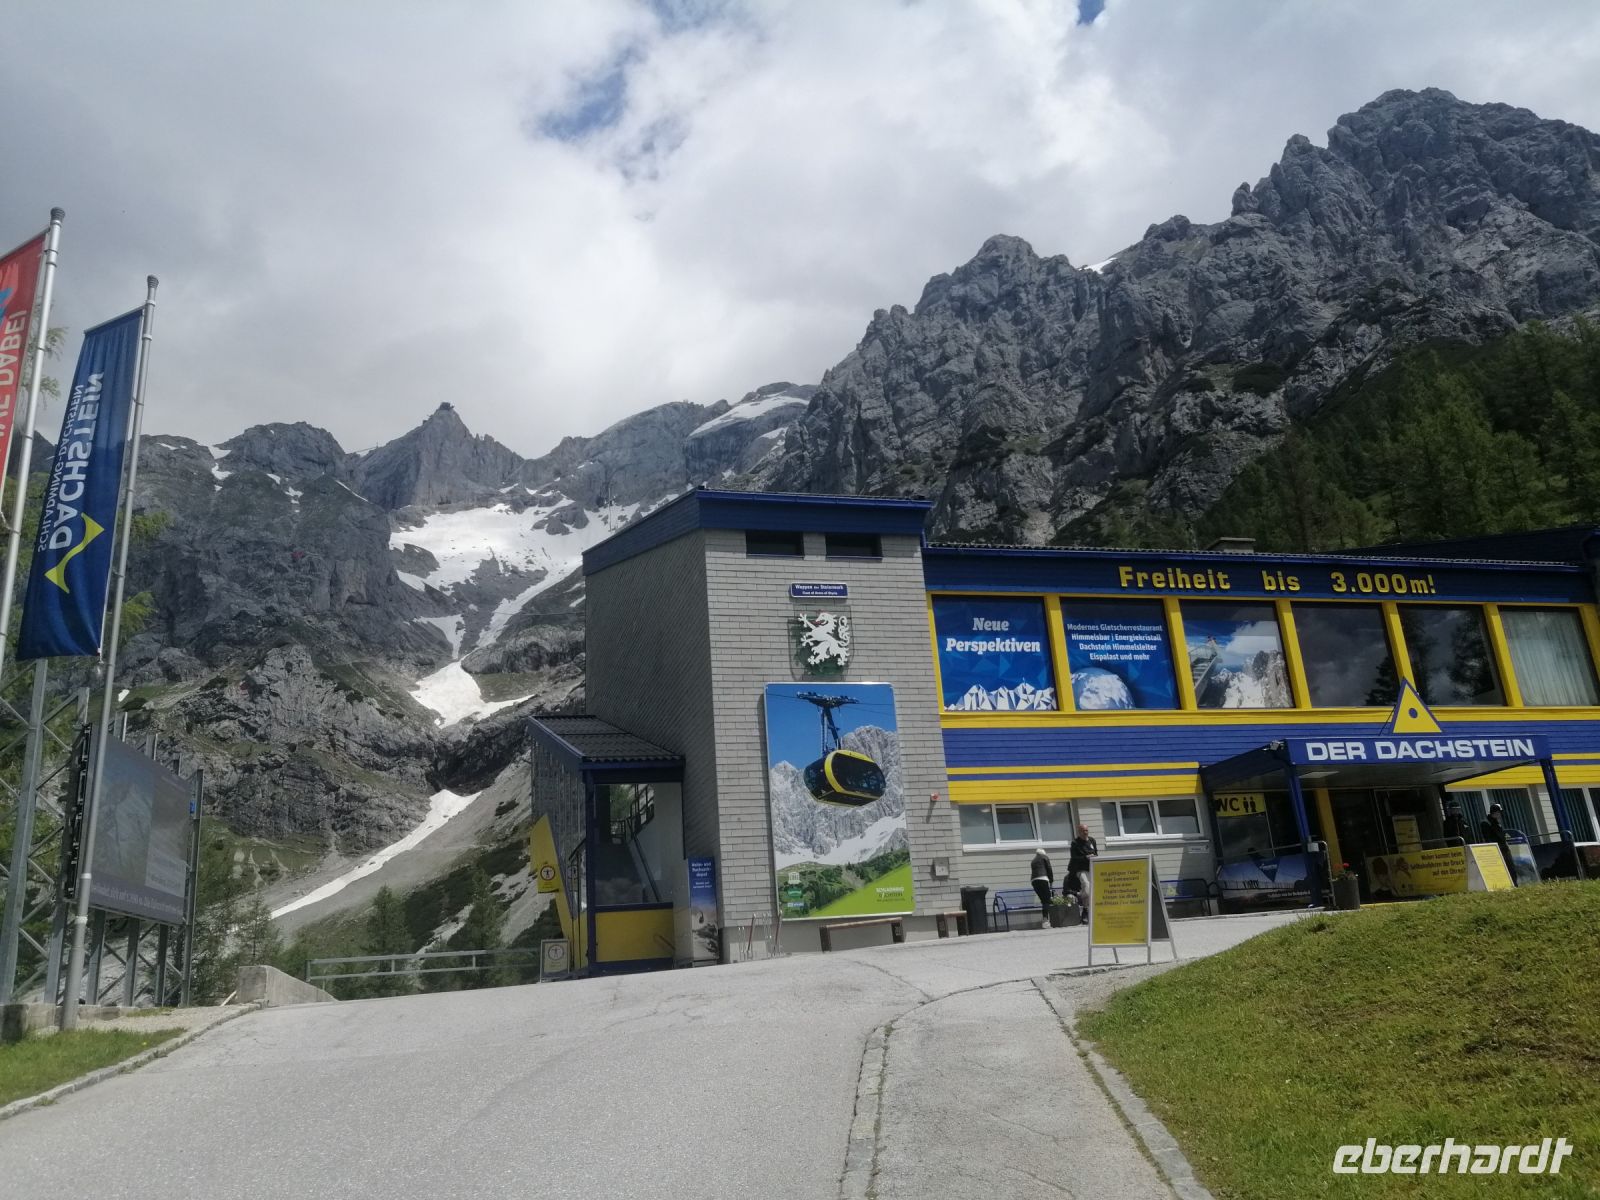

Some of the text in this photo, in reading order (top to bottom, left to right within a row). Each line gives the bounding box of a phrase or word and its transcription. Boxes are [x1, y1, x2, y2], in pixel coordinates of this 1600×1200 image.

[1118, 566, 1437, 594] Freiheit bis 3.000m!
[973, 618, 1010, 631] Neue
[1100, 624, 1163, 632] Gletscherrestaurant
[1071, 633, 1162, 642] Himmelsbar Energiekristall
[946, 637, 1041, 655] Perspektiven
[1112, 643, 1157, 651] Himmelsleiter
[1089, 653, 1119, 661] Eispalast
[1305, 739, 1536, 761] DER DACHSTEIN
